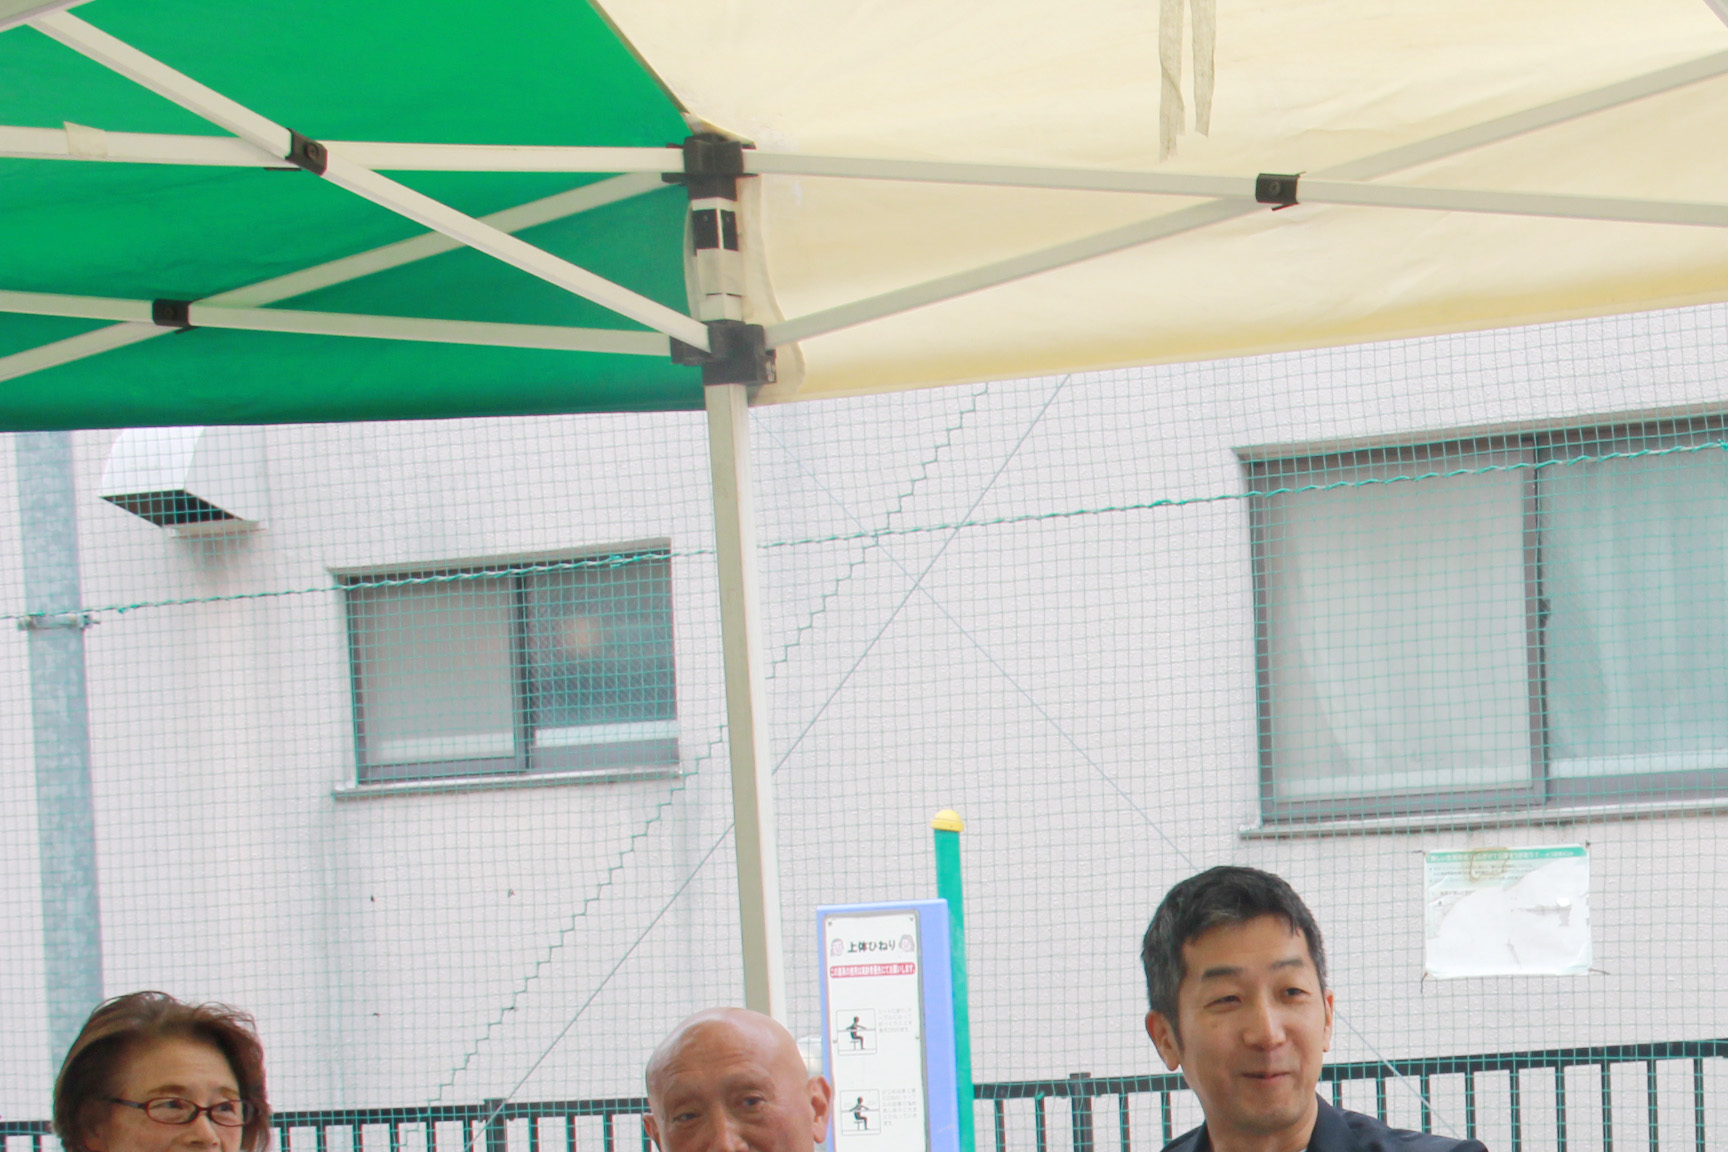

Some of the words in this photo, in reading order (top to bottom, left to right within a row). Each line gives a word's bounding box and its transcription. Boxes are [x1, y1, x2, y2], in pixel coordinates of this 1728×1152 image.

[847, 940, 896, 953] 上体ひねり
